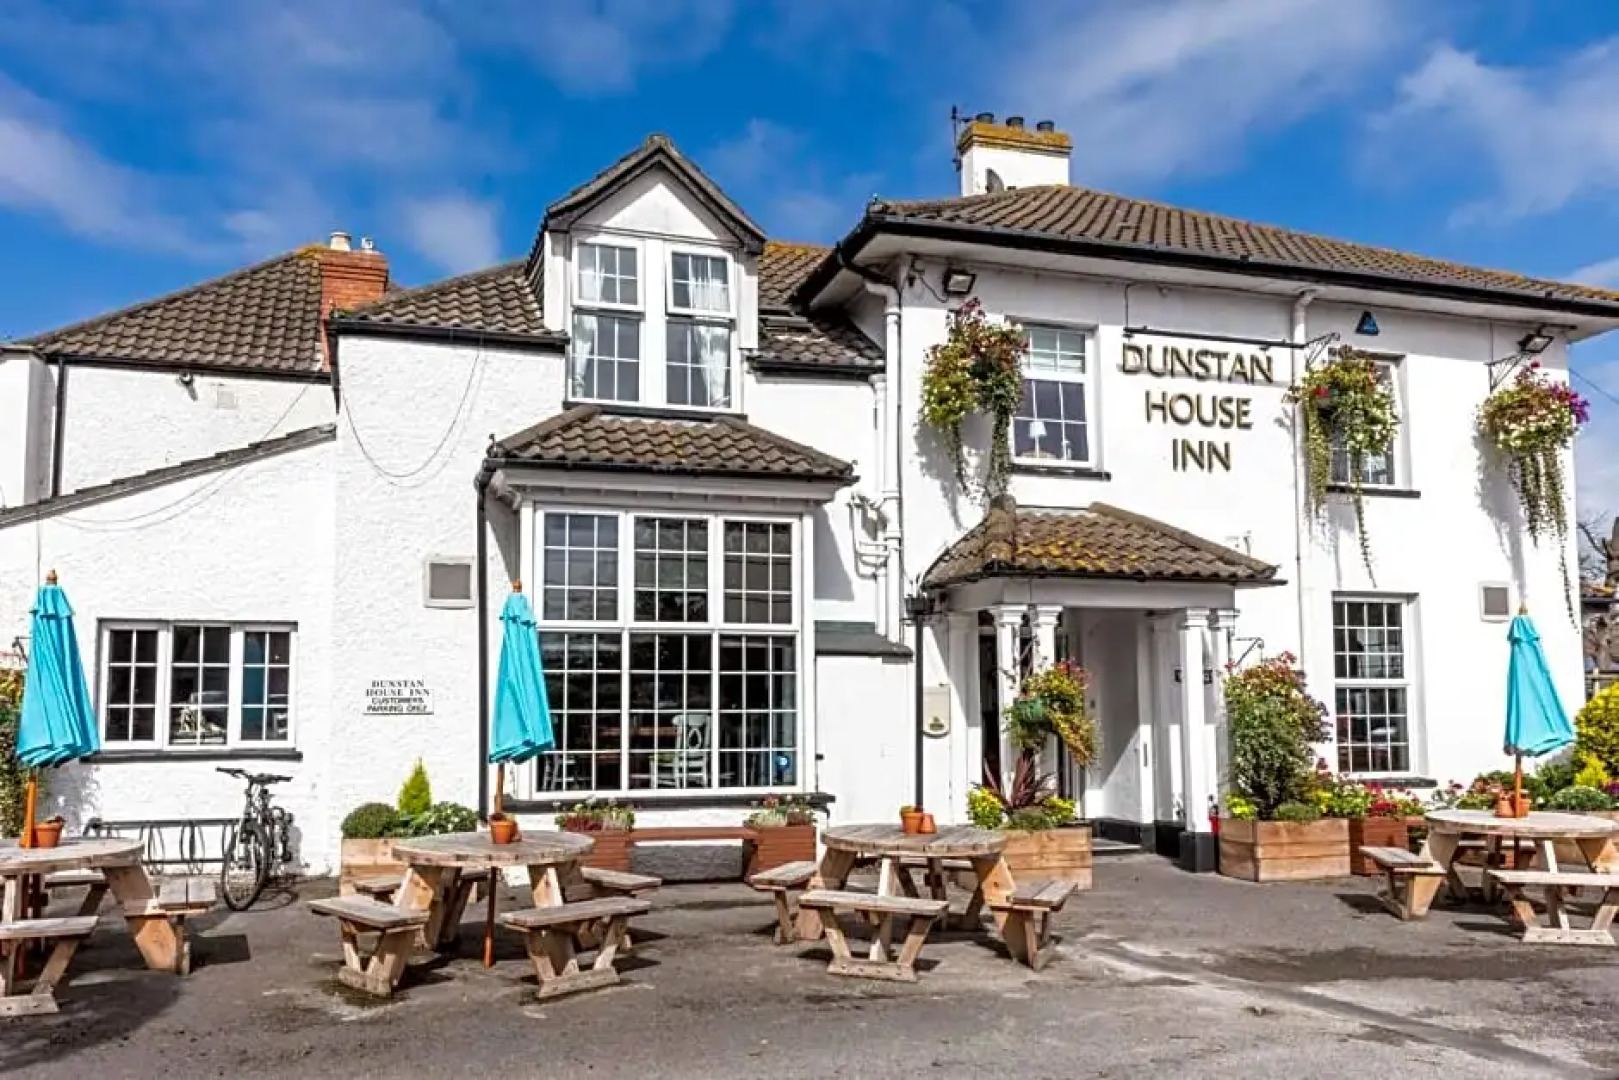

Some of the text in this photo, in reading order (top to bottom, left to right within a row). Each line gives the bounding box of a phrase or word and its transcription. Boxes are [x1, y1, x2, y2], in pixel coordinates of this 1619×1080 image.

[1122, 343, 1274, 384] DUNSTAN
[1145, 390, 1254, 430] HOUSE
[1172, 438, 1231, 473] INN
